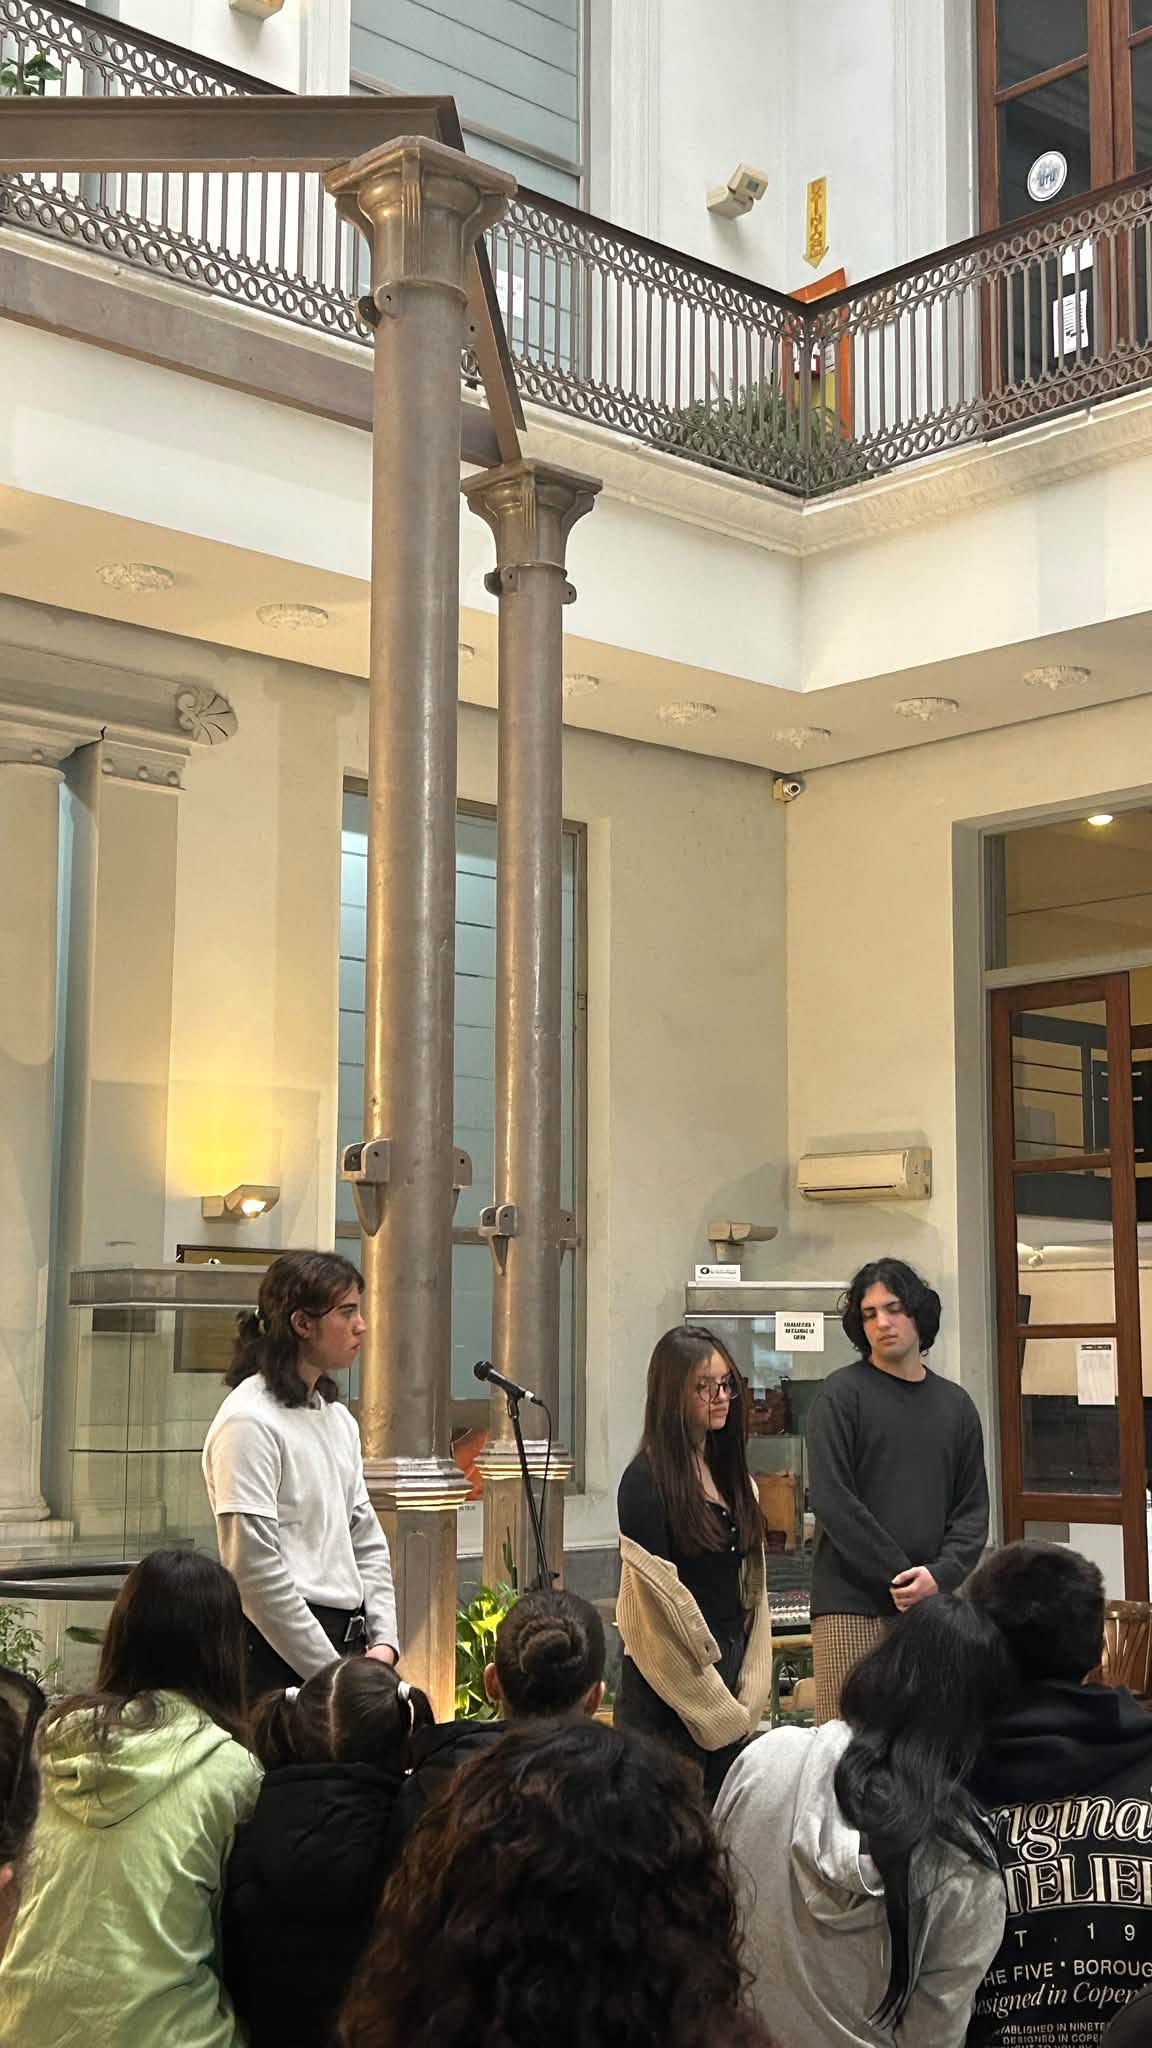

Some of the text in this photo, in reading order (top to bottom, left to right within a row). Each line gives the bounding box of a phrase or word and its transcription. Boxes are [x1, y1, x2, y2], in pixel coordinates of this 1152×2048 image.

[987, 1796, 1152, 1862] rigina
[1003, 1855, 1152, 1914] TELIE
[983, 1969, 1008, 1988] HE
[1013, 1961, 1054, 1983] FIVE
[972, 1983, 1047, 2018] esigned
[1047, 1984, 1067, 2005] in
[1056, 2022, 1067, 2033] IN
[1057, 2033, 1069, 2044] IN
[1071, 2032, 1103, 2043] COPE
